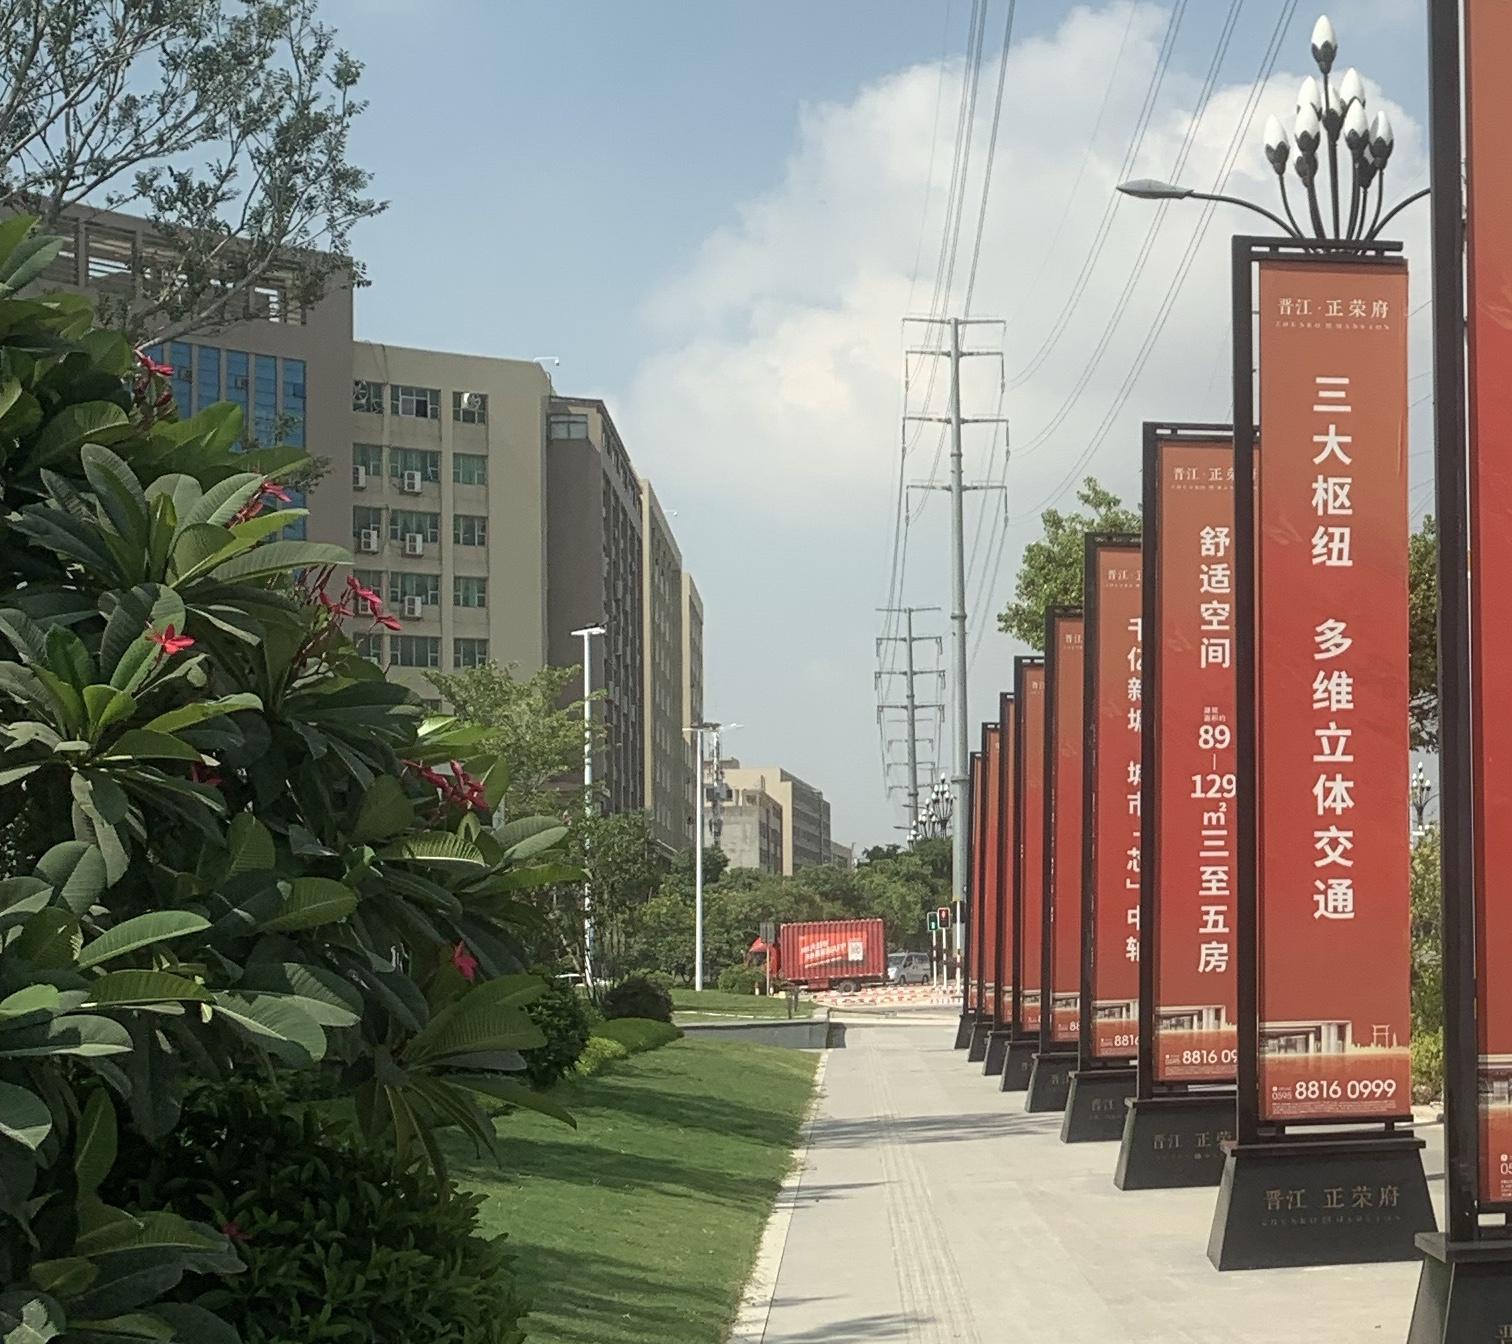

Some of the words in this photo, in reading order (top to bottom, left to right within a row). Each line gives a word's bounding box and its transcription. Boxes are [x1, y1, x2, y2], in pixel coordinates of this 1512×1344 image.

[1311, 376, 1353, 567] 三大枢纽
[1199, 526, 1230, 669] 舒适空间
[1312, 618, 1354, 920] 多维立体交通
[1182, 1050, 1217, 1064] 8816
[1295, 1080, 1341, 1099] 8816
[1347, 1079, 1396, 1098] 0999
